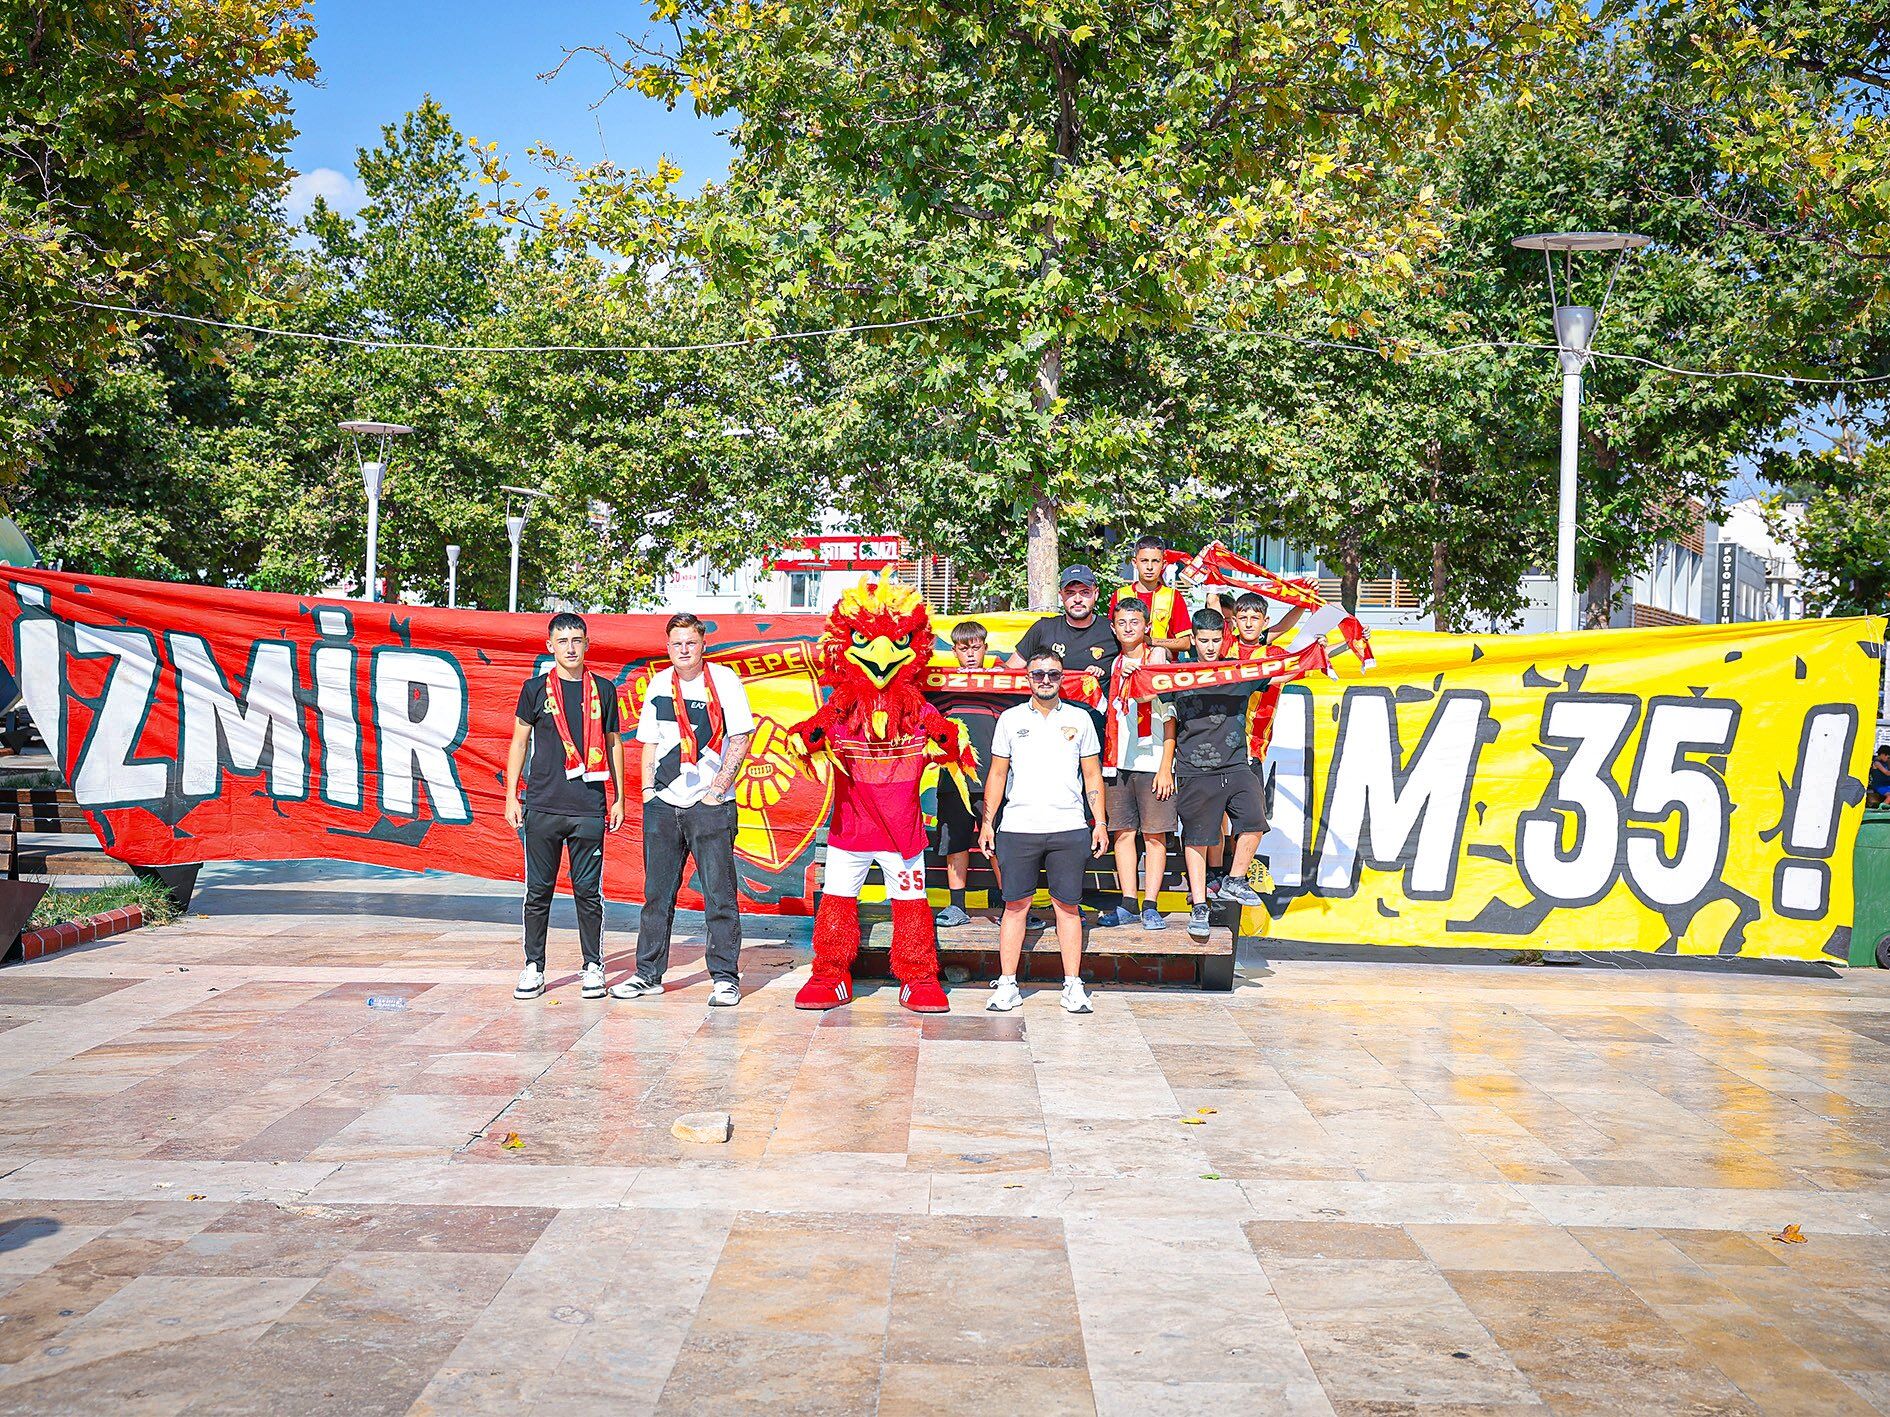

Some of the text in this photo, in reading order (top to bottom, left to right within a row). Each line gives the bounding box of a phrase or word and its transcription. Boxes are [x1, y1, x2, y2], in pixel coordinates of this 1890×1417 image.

[1722, 547, 1732, 580] FOTO
[717, 646, 805, 676] TEPE
[1151, 656, 1300, 691] GÖZTEPE
[926, 669, 1030, 689] ÖZTEP
[13, 582, 473, 824] İZMİR
[690, 701, 707, 710] EA7
[1517, 694, 1741, 910] 35
[897, 870, 924, 891] 35
